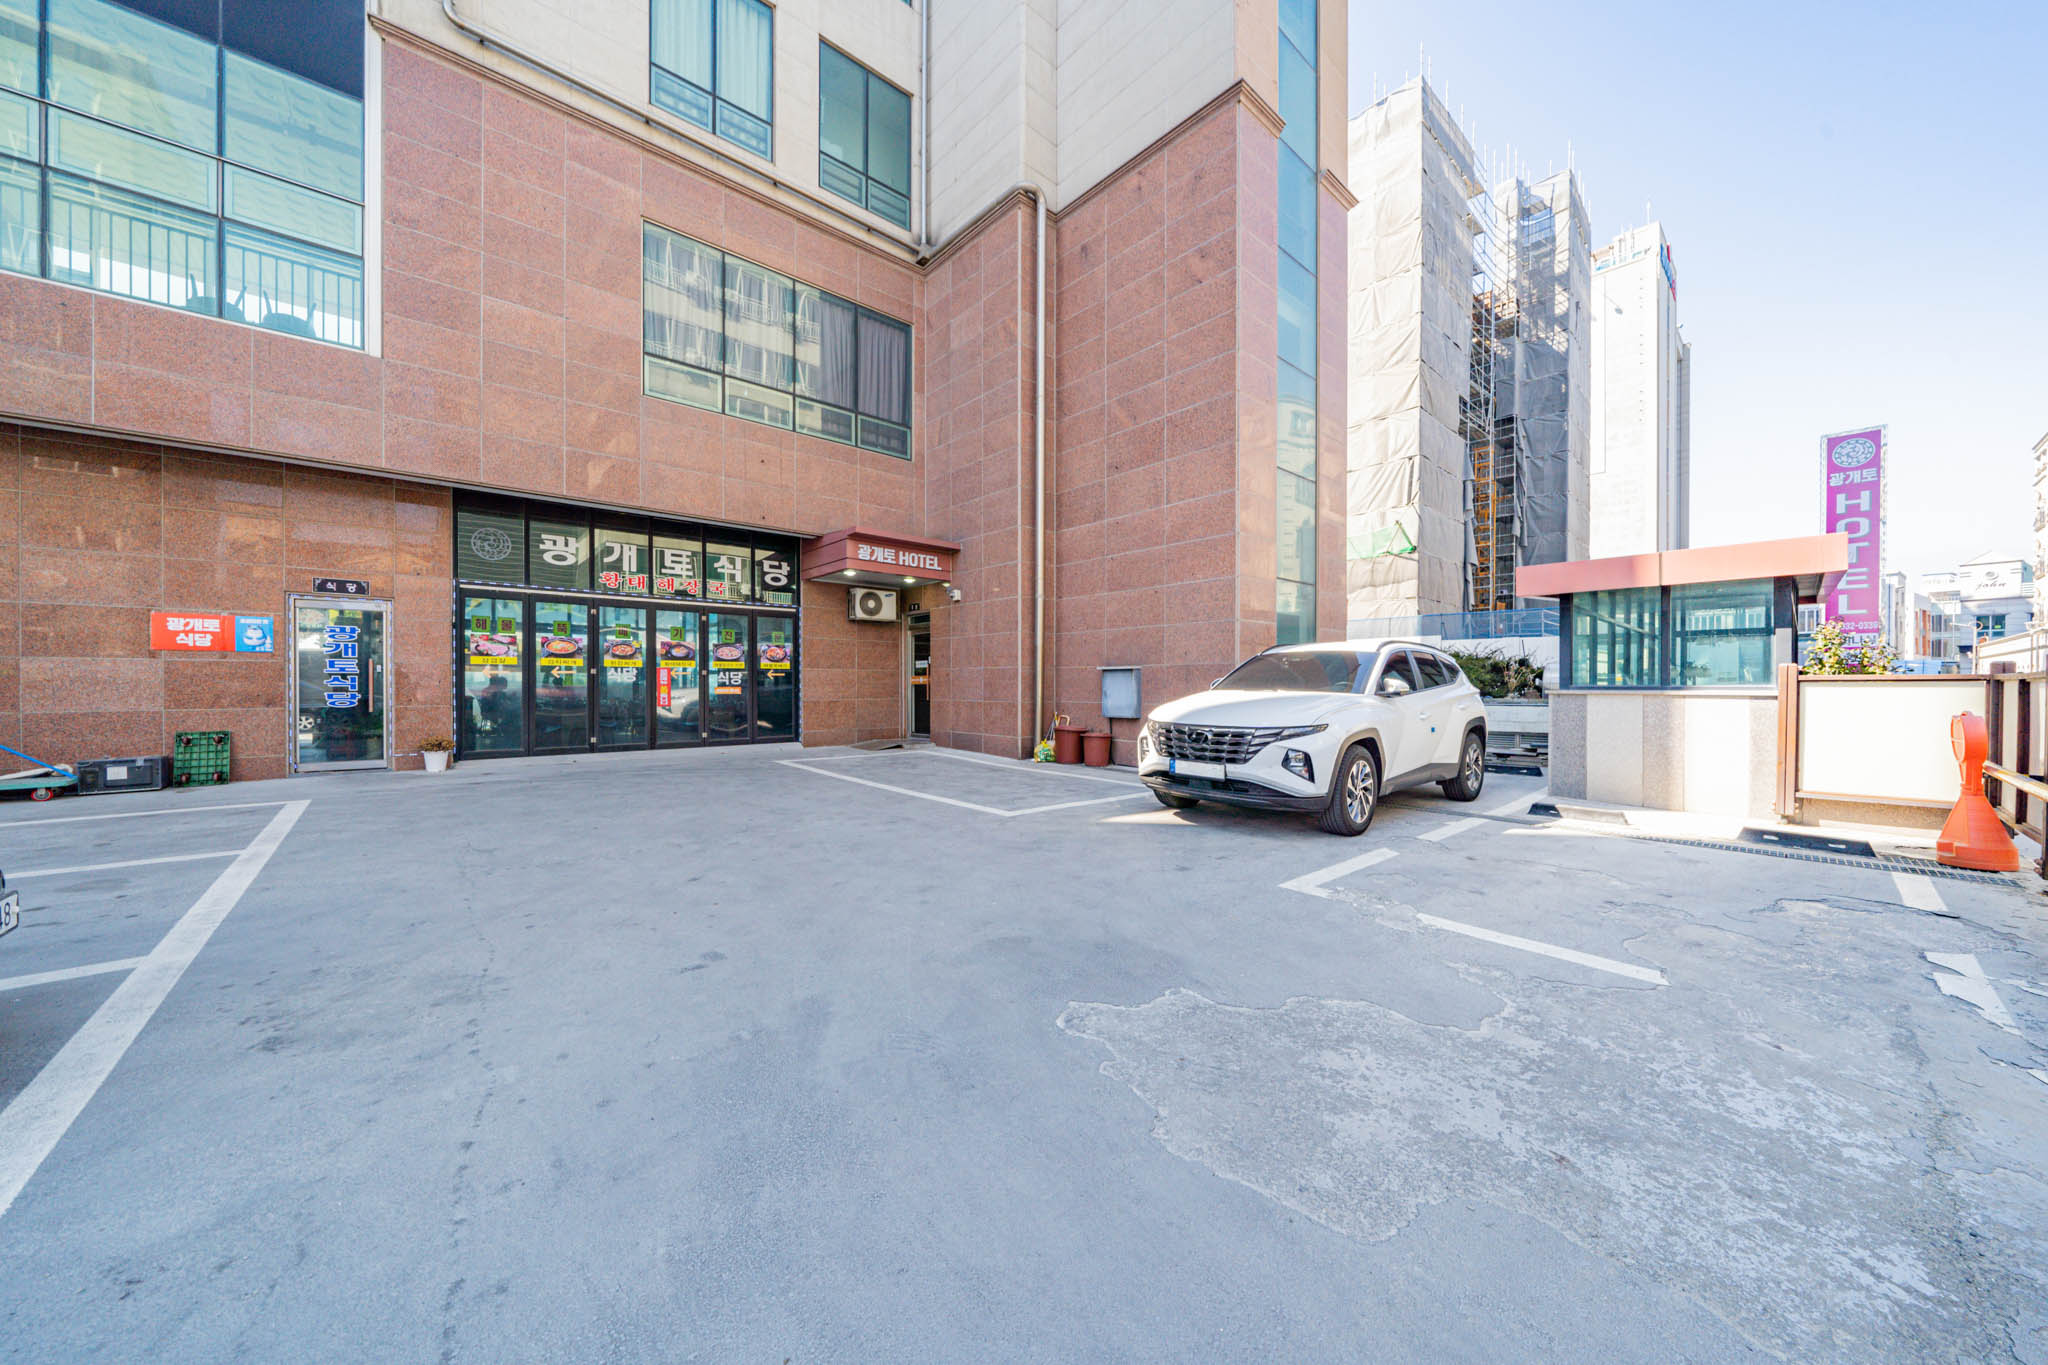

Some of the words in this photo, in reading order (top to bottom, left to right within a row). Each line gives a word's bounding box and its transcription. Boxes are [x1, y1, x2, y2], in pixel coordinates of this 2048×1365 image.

[1829, 468, 1878, 486] 광개토
[539, 533, 791, 587] 광개토식당
[858, 544, 896, 564] 광개토
[899, 551, 942, 570] HOTEL
[1836, 491, 1871, 615] HOTEL
[599, 571, 727, 596] 황태해장국
[176, 633, 213, 647] 식당
[324, 625, 361, 708] 광개토식당
[607, 667, 638, 682] 식당
[717, 671, 743, 686] 식당
